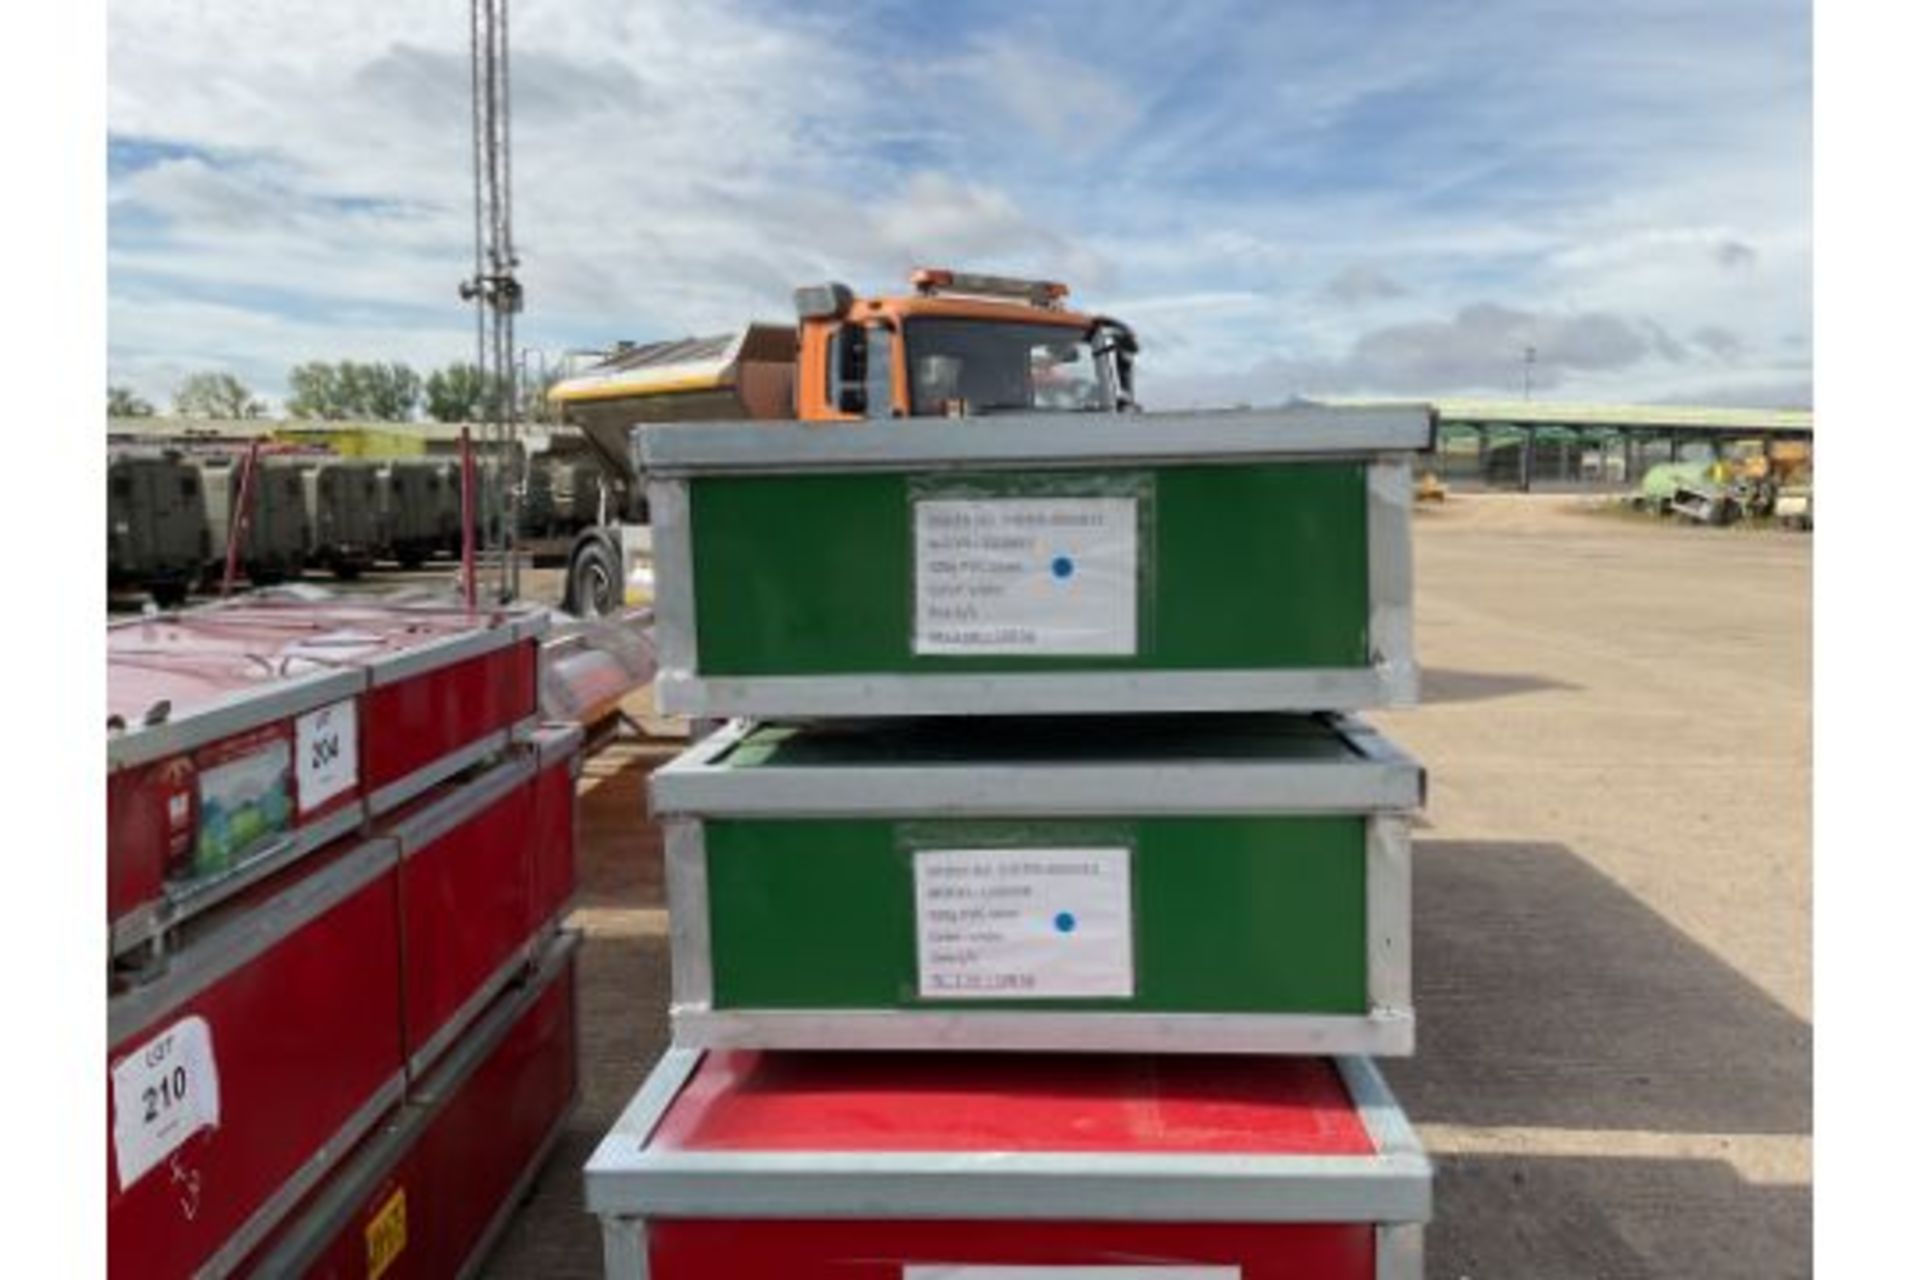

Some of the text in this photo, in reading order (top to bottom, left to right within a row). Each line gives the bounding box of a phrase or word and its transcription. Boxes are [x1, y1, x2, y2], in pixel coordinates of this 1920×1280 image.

[312, 734, 339, 770] 204
[146, 1035, 173, 1067] LOT
[142, 1066, 186, 1123] 210
